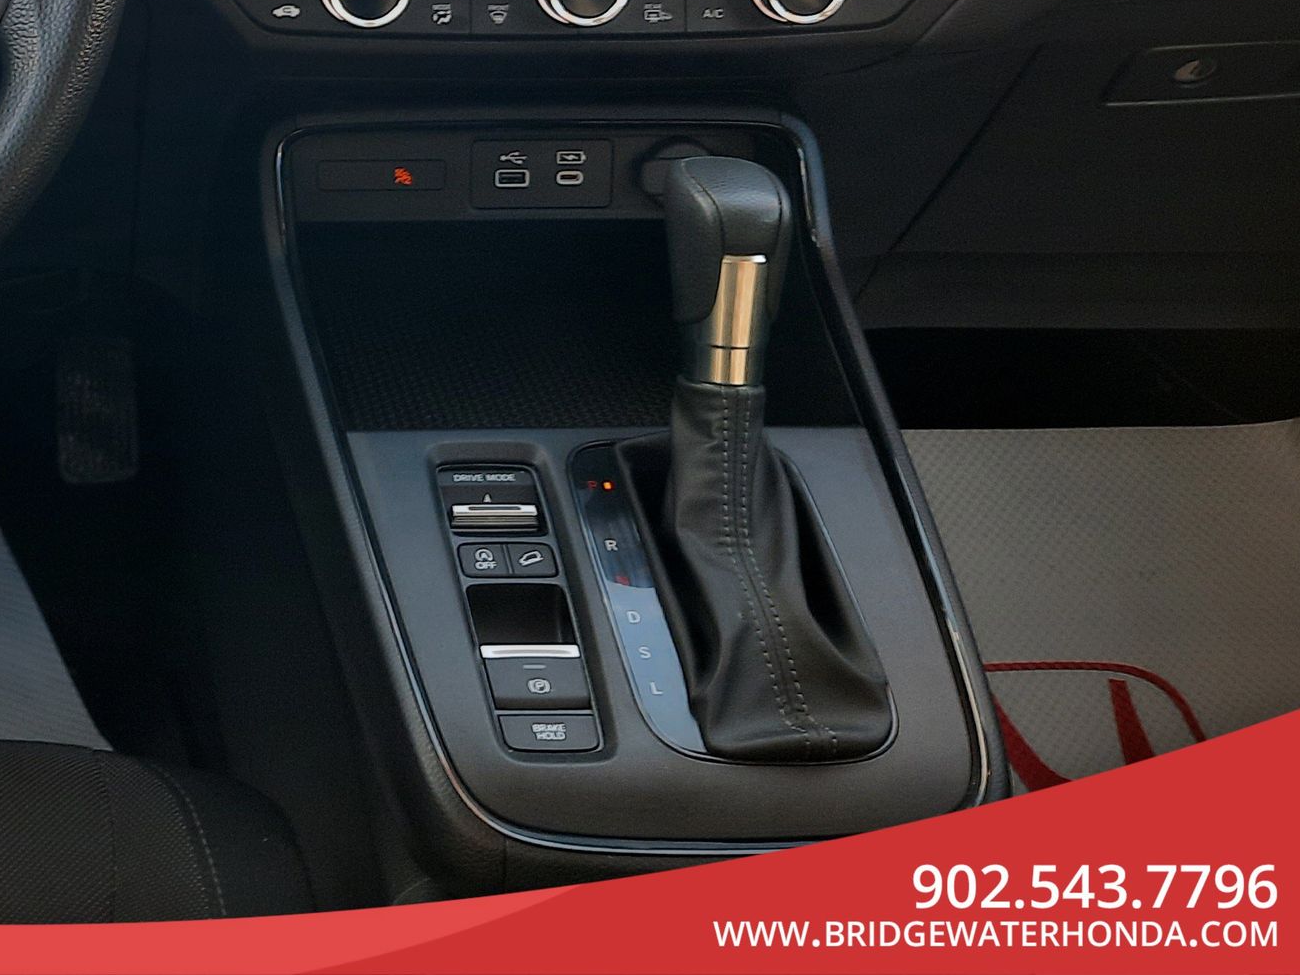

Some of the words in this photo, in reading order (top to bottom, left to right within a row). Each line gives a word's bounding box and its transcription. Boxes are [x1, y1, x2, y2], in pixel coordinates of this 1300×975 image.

[703, 8, 725, 19] A/C
[453, 473, 484, 483] DRIVE
[485, 473, 516, 483] MODE
[604, 539, 618, 552] R
[474, 561, 497, 571] OFF
[626, 610, 641, 625] D
[638, 645, 651, 659] S
[650, 681, 663, 695] L
[532, 723, 567, 733] BRAKE
[536, 731, 566, 741] HOLD
